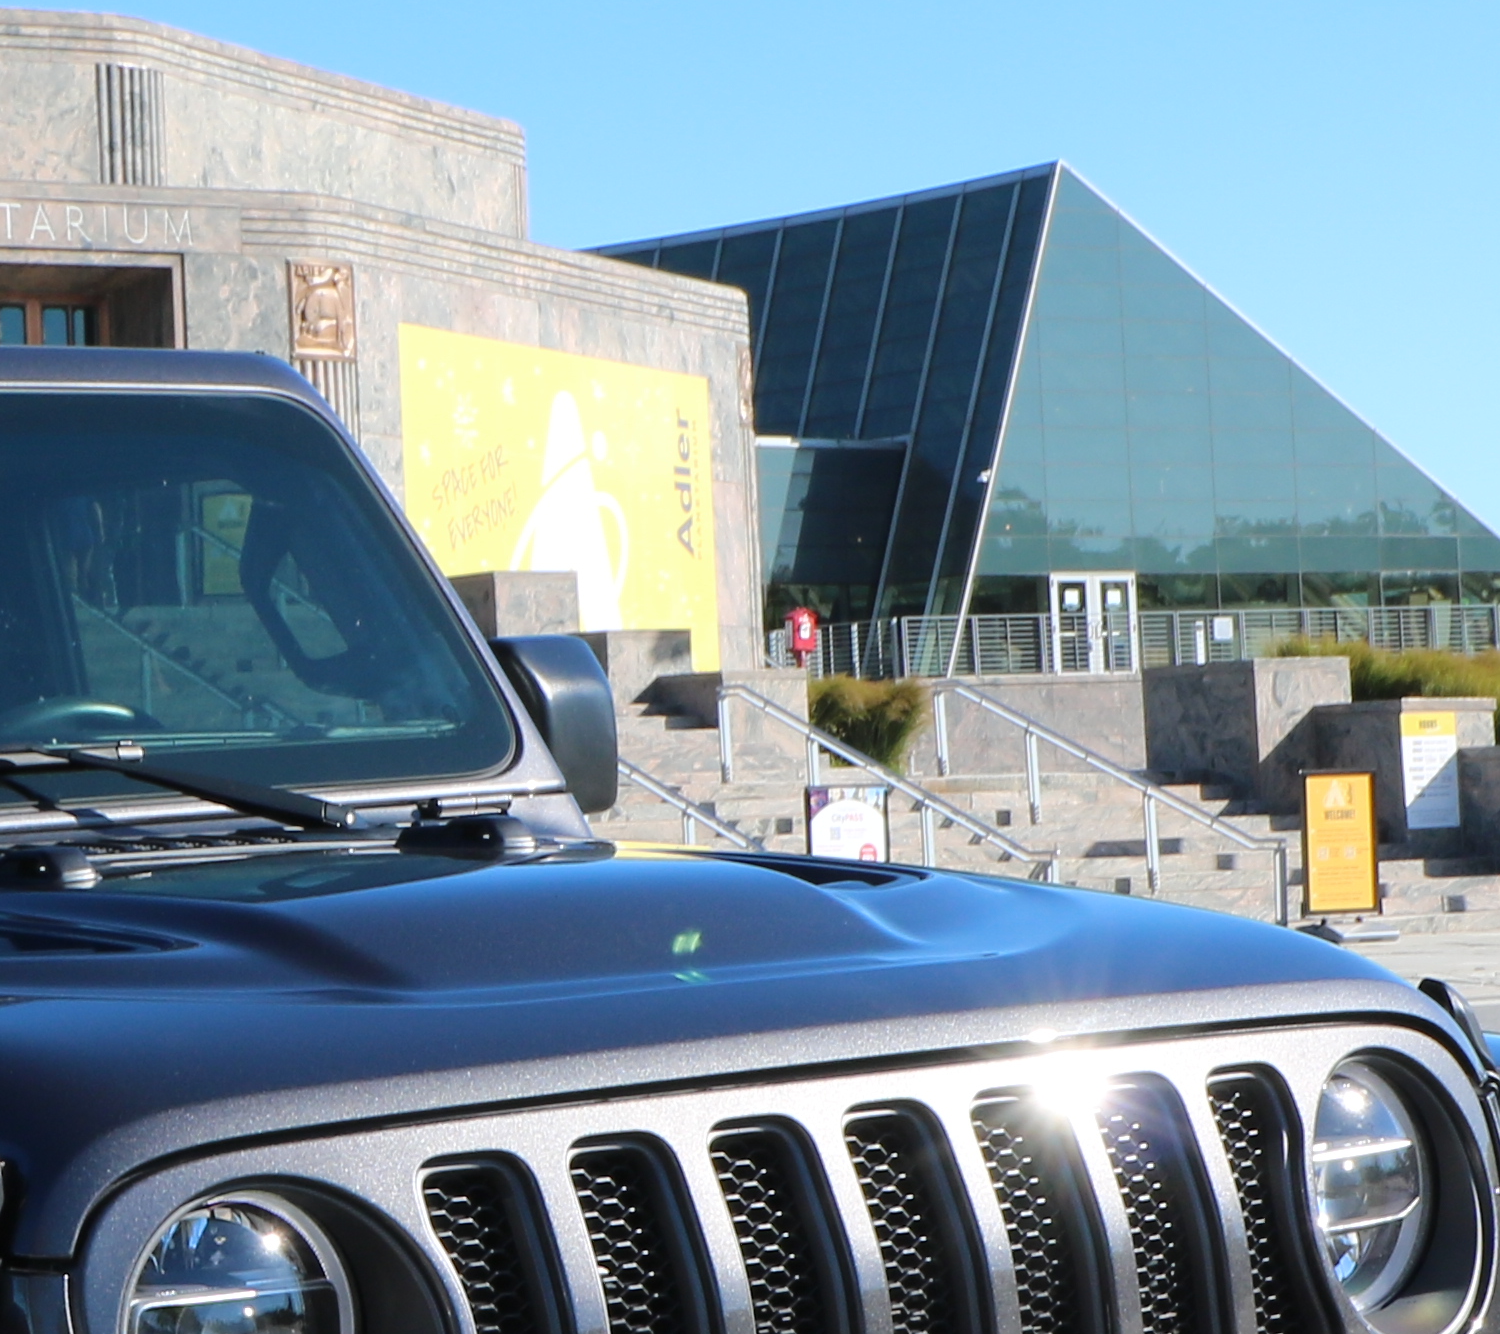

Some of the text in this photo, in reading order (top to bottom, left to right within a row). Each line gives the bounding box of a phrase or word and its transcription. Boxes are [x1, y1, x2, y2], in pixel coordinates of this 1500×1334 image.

[431, 443, 510, 512] SPACE FOR
[673, 407, 696, 559] Adler
[446, 480, 521, 553] EVERYONE!
